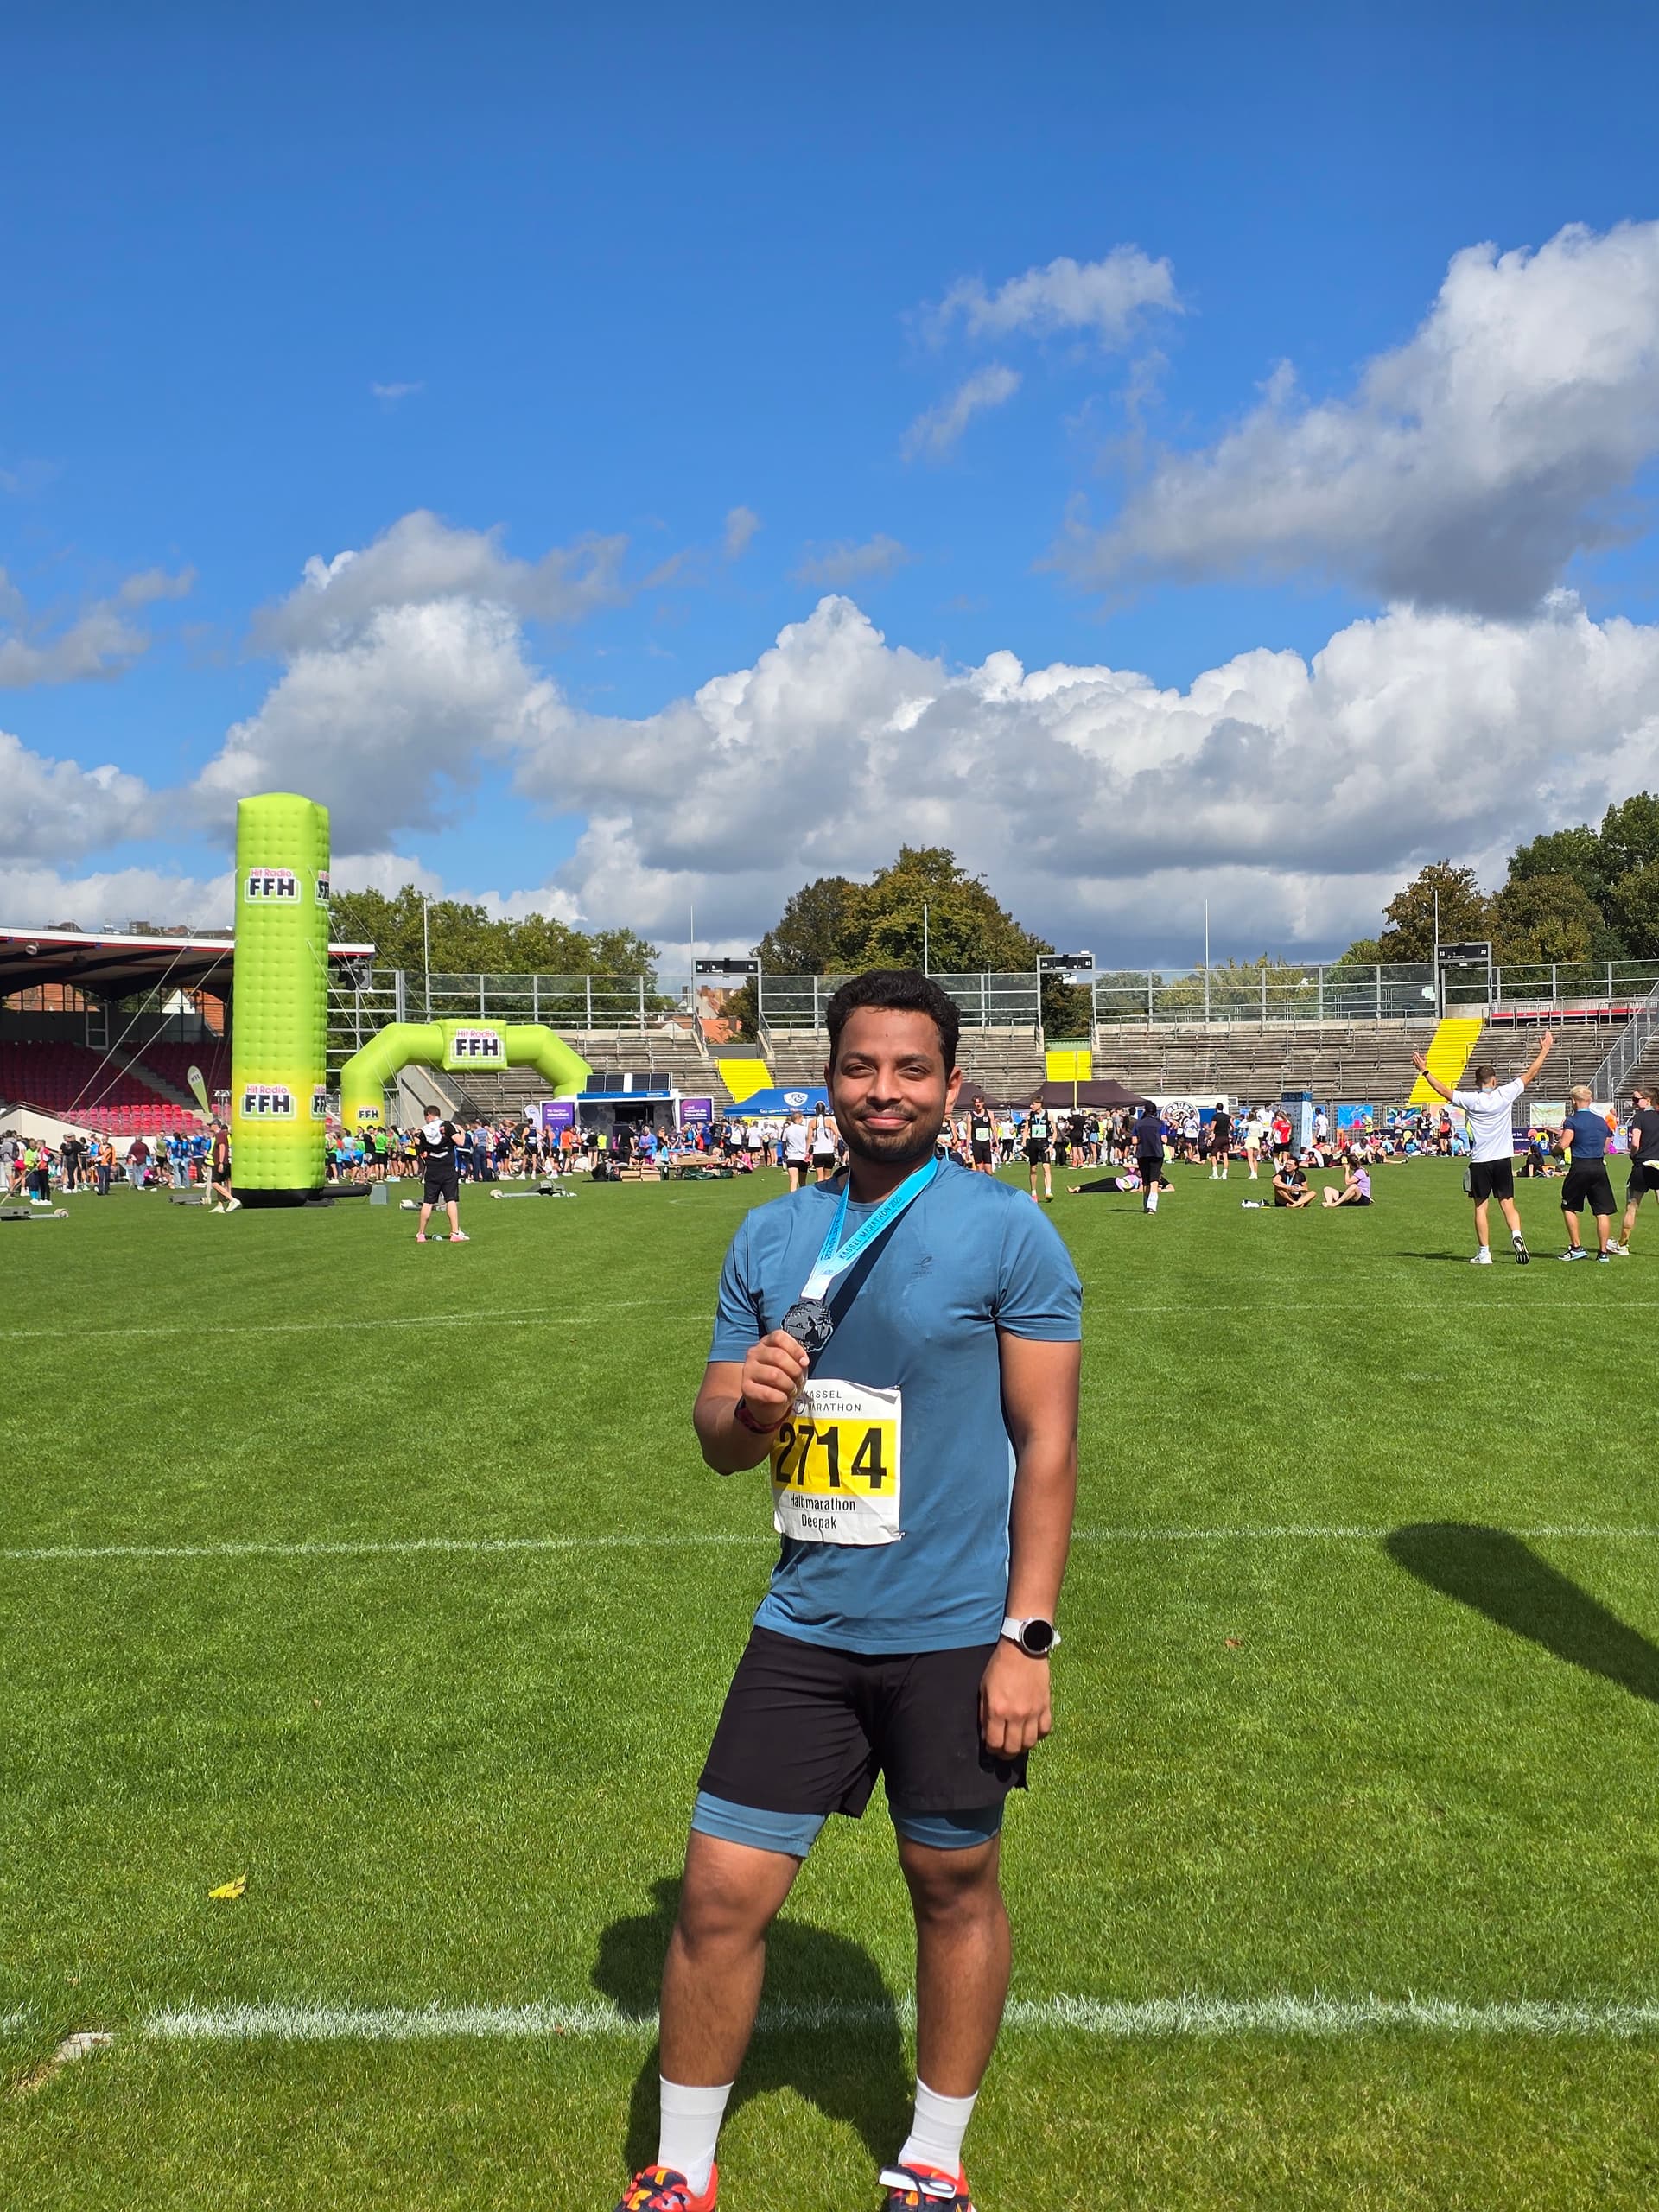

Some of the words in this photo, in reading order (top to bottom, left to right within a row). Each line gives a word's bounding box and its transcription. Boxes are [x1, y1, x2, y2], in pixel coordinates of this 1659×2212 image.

[250, 878, 295, 896] FFH
[457, 1029, 468, 1038] Hit
[470, 1029, 496, 1038] Radio
[456, 1039, 499, 1056] FFH
[246, 1085, 258, 1094] Hit
[259, 1085, 288, 1094] Radio
[245, 1094, 290, 1113] FFH
[839, 1236, 863, 1260] KASSEL
[860, 1206, 892, 1236] MARATHON
[888, 1194, 903, 1209] 2025
[775, 1422, 887, 1489] 2714
[790, 1492, 856, 1511] Halbmarathon
[801, 1513, 837, 1529] Deepak
